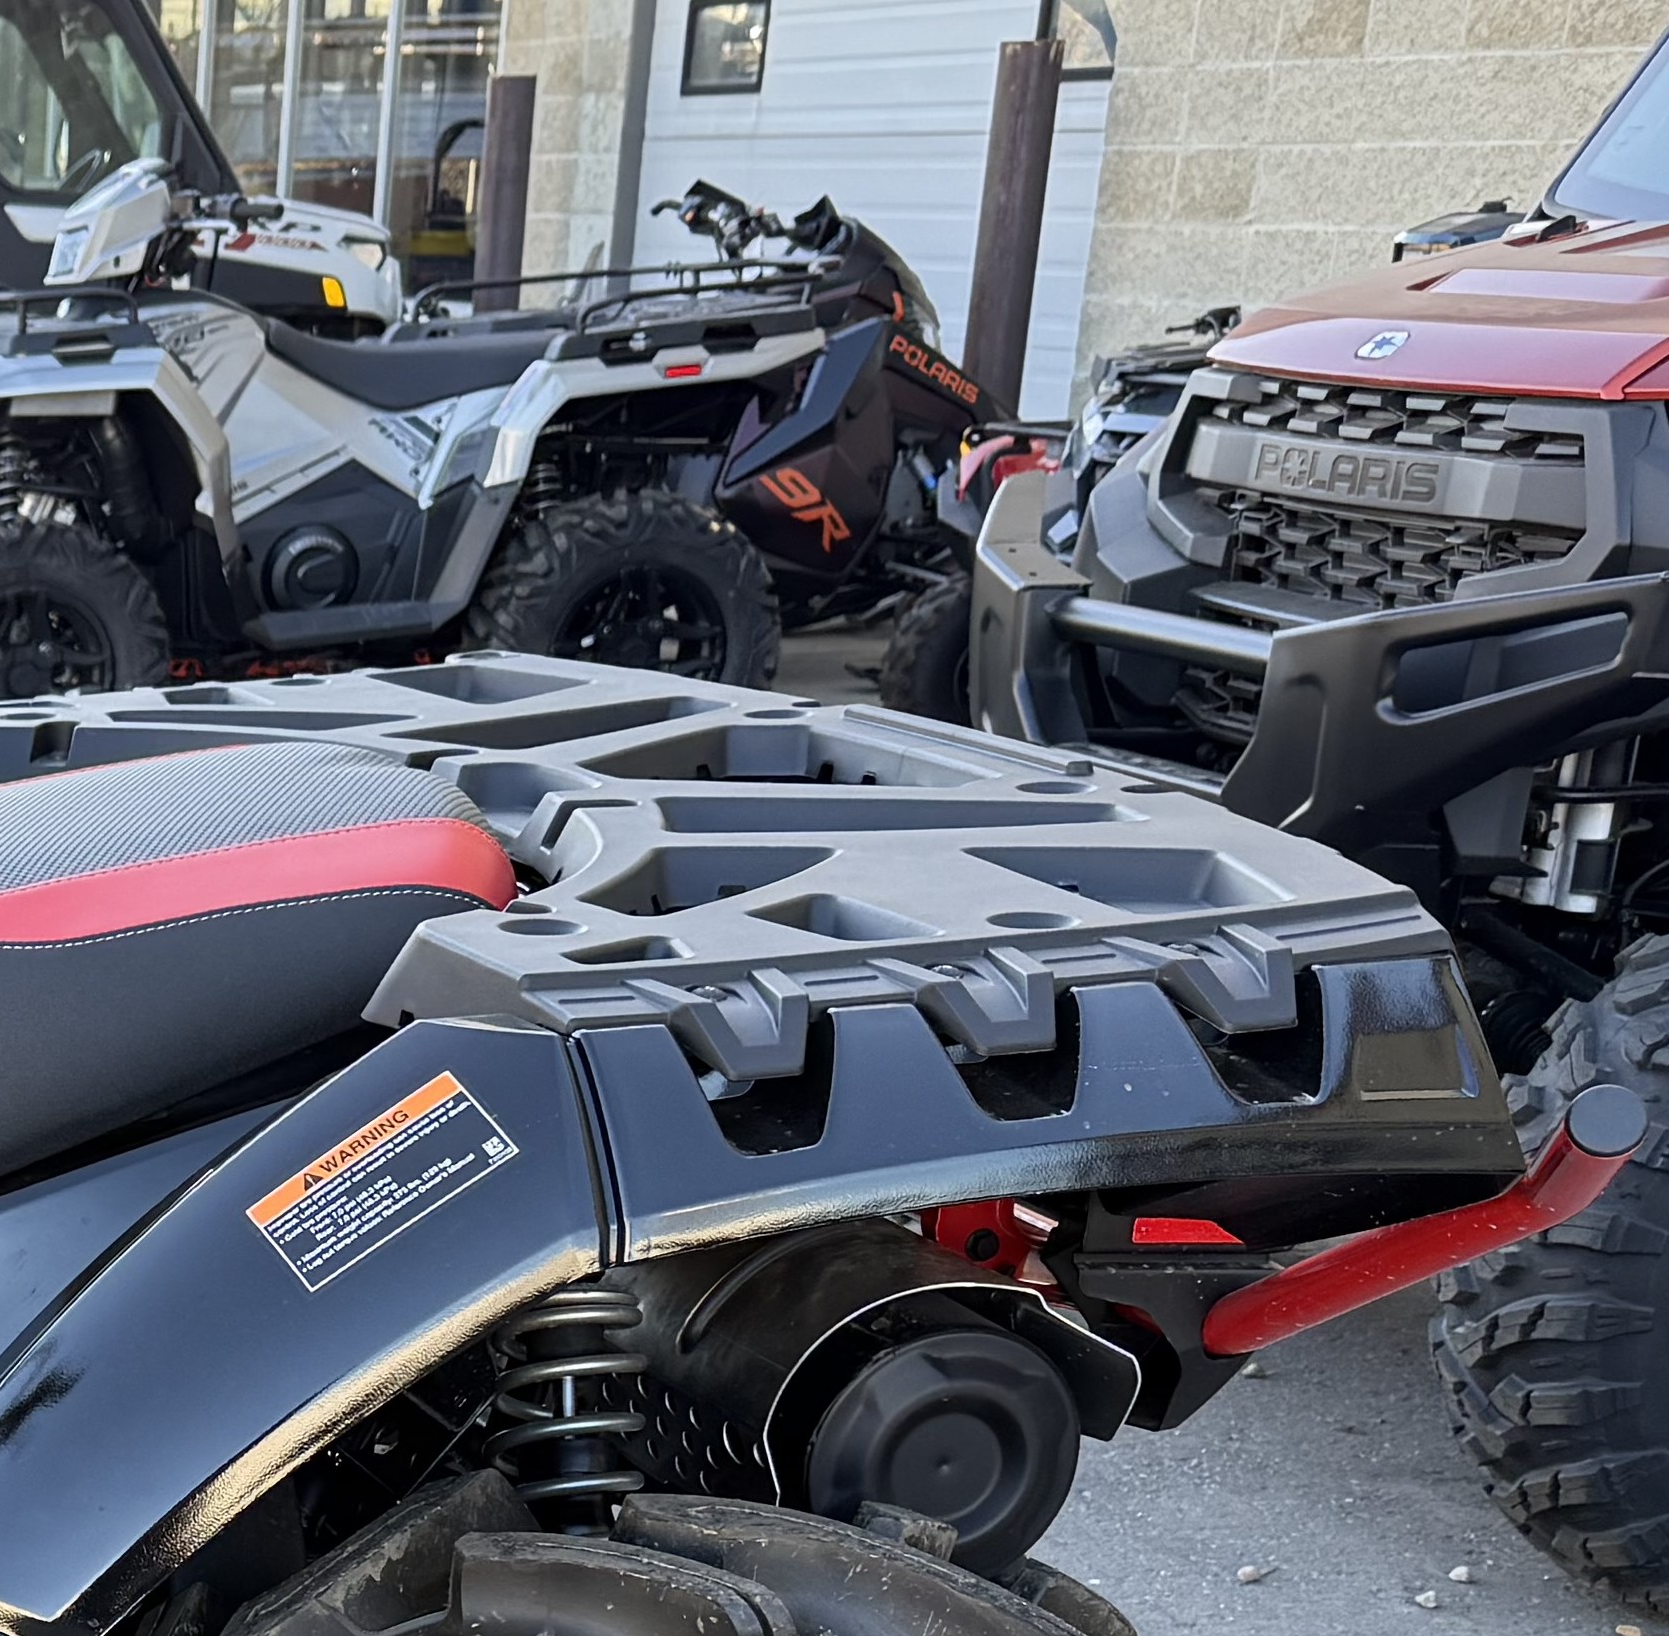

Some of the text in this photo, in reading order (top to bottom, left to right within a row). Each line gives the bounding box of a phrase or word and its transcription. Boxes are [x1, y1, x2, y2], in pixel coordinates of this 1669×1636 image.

[889, 334, 979, 404] POLARIS
[1254, 442, 1441, 503] POLARIS
[319, 1109, 410, 1174] WARNING
